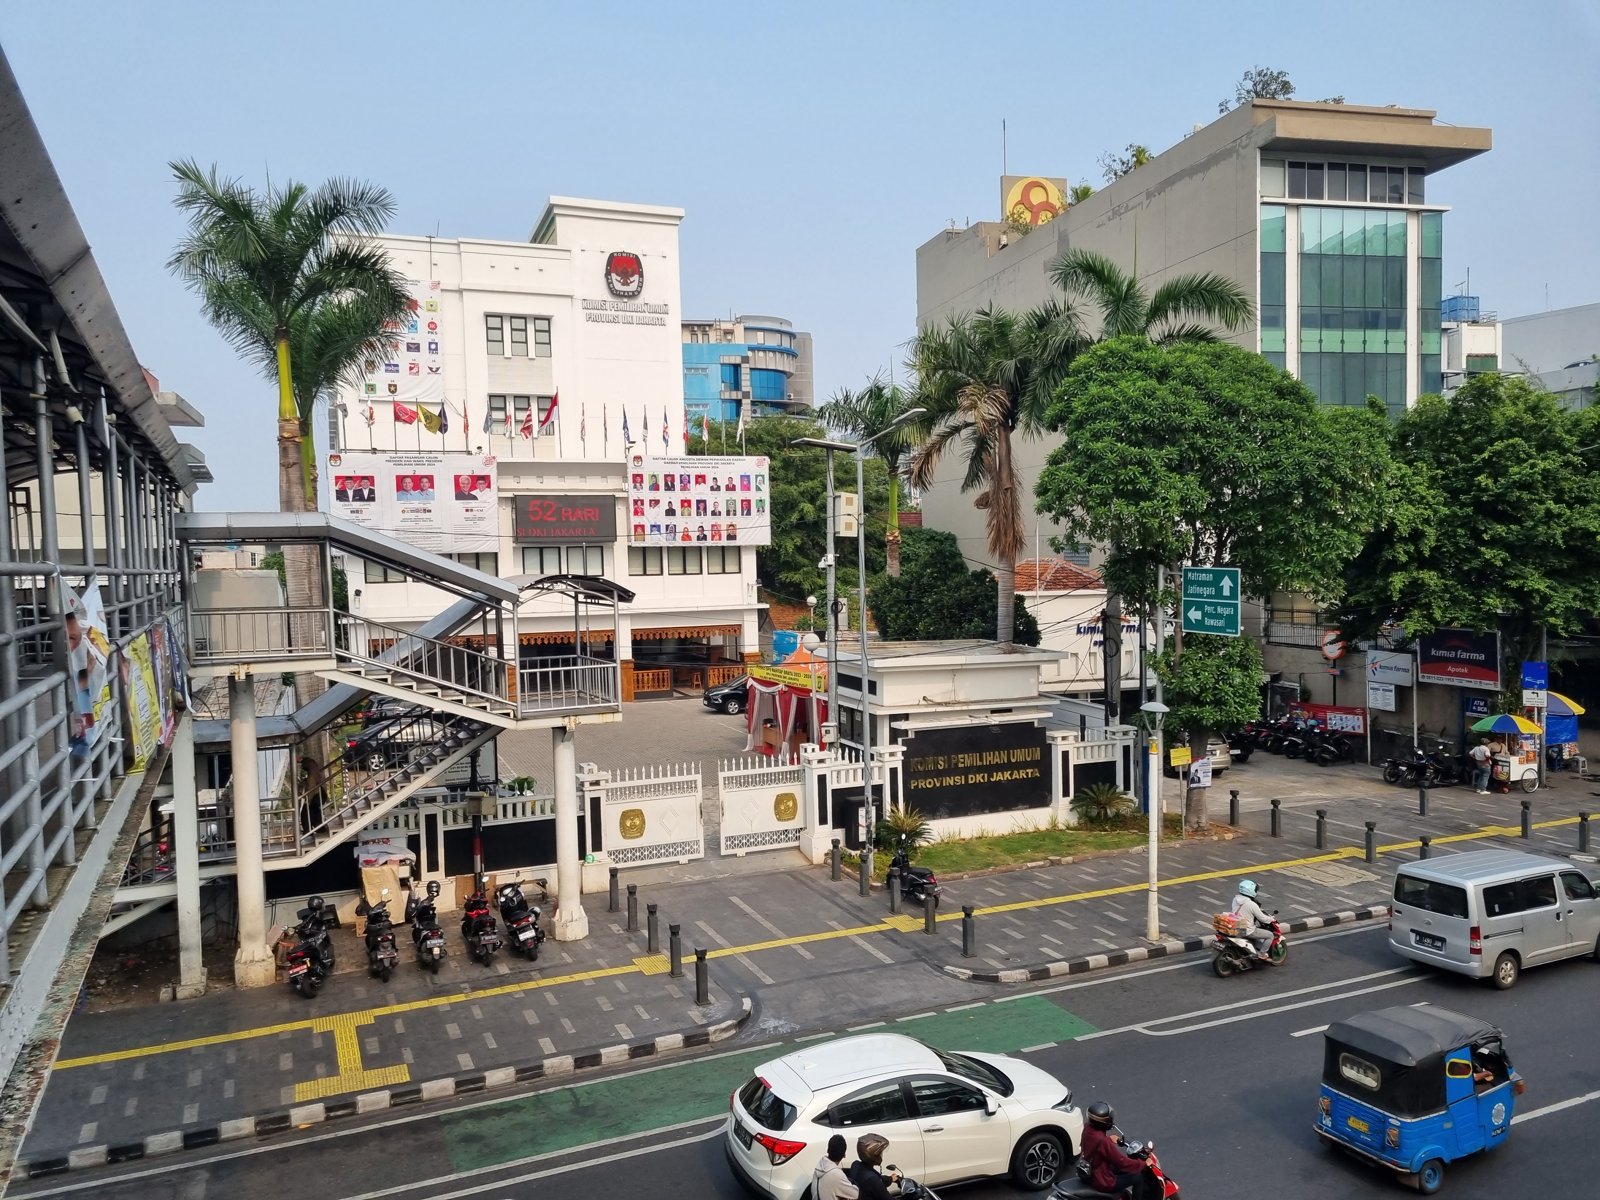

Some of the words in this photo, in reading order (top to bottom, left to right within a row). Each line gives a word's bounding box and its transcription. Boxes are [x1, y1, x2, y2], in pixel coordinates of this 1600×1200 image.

[582, 300, 608, 310] KOMISI
[610, 302, 646, 313] PEMILIHAN
[647, 304, 669, 315] UMUM
[586, 312, 620, 324] PROVINSI
[622, 314, 634, 325] DKI
[635, 316, 666, 326] JAKARTA
[529, 499, 557, 521] 52
[561, 507, 600, 521] HARI
[551, 528, 596, 536] JAKARTA
[1188, 572, 1213, 581] Matraman
[1187, 585, 1215, 597] Jatinegara
[1204, 605, 1215, 614] Perc.
[1217, 606, 1234, 616] Negara
[1204, 617, 1225, 626] Rawasari
[1431, 648, 1455, 658] kimia
[1457, 650, 1485, 660] farma
[910, 756, 948, 772] KOMISI
[951, 750, 1008, 768] PEMILIHAN
[1010, 747, 1040, 763] UMUM
[910, 775, 965, 789] PROVINSI
[968, 773, 987, 784] DKI
[990, 768, 1040, 782] JAKARTA
